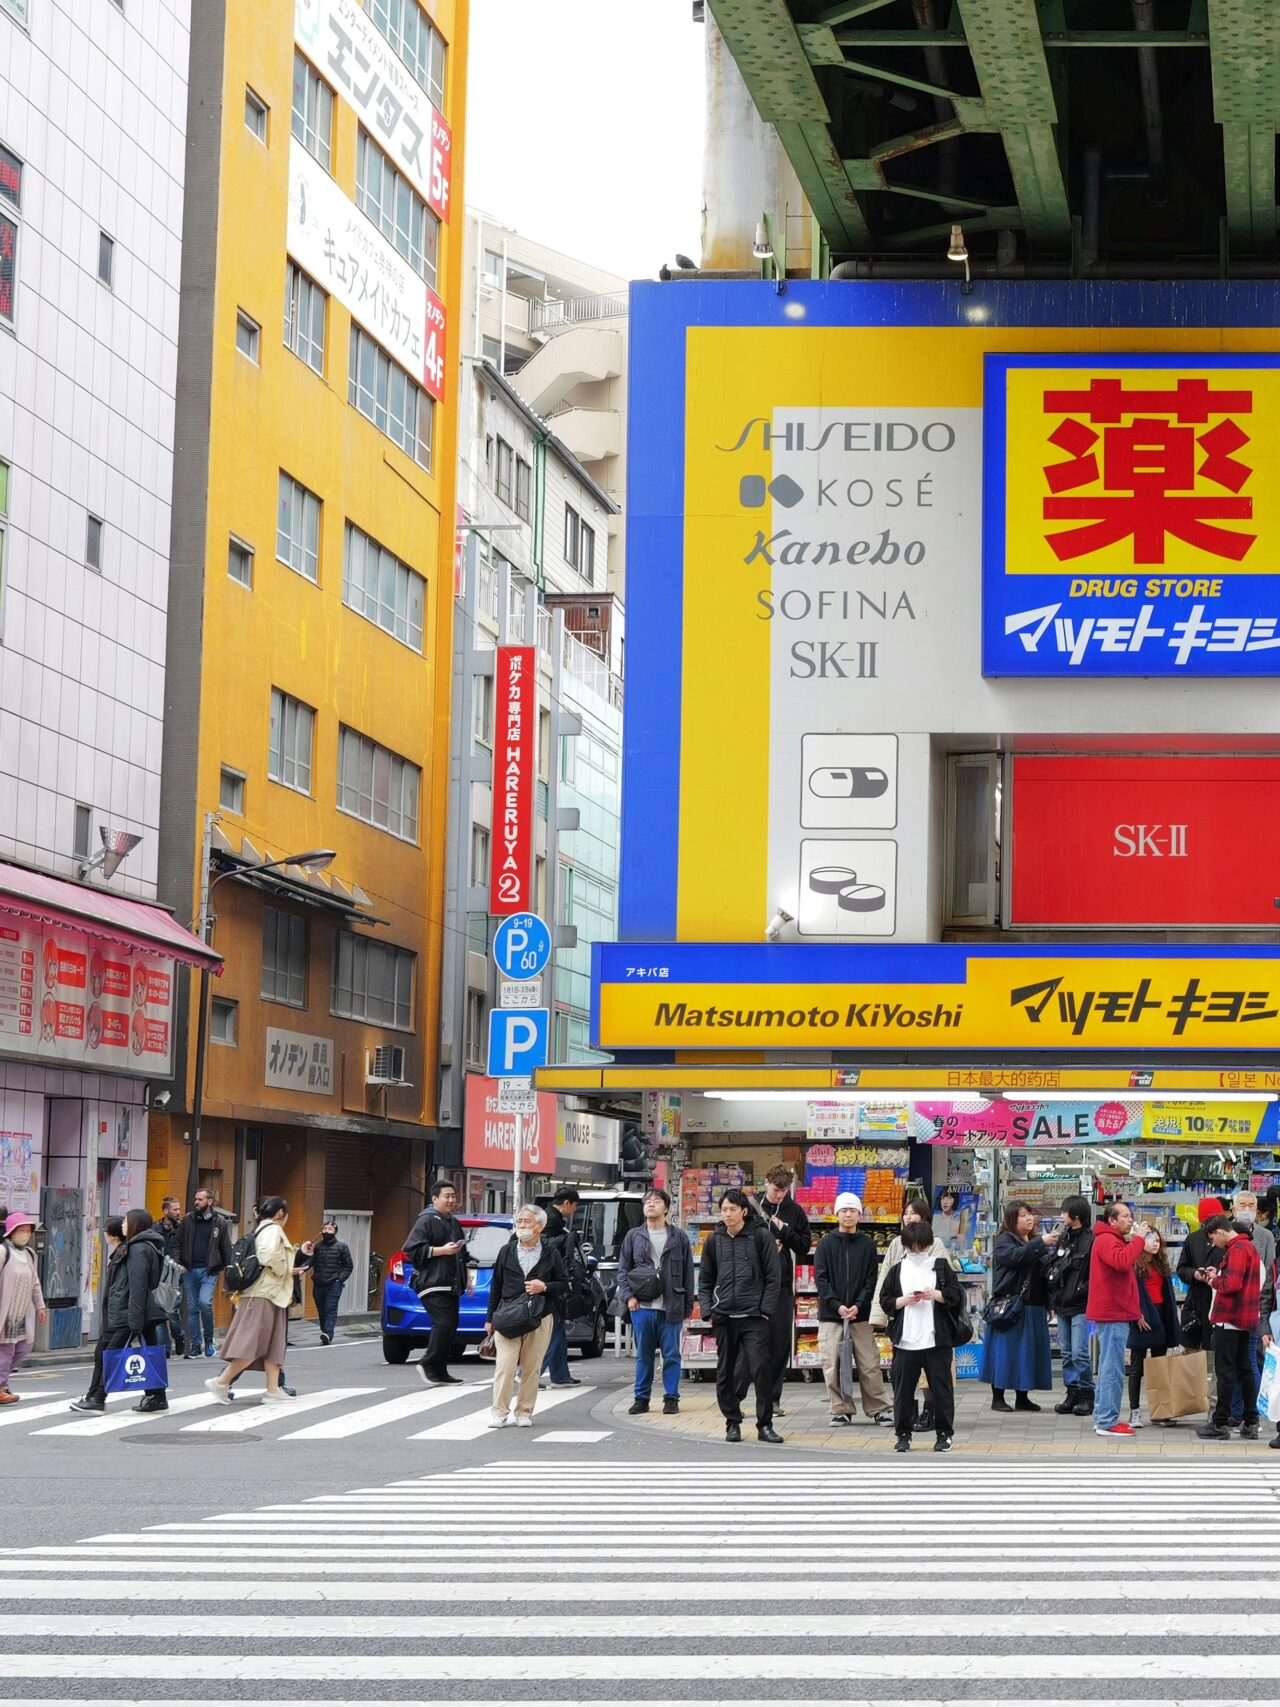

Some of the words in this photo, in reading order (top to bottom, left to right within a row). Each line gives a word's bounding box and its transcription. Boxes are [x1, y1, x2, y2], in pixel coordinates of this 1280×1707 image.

[327, 13, 424, 182] エンタス
[432, 120, 450, 151] オノデン
[431, 147, 448, 210] 5F
[323, 227, 421, 362] キュアメイドカフェ
[426, 300, 445, 329] オノデン
[424, 331, 444, 389] 4F
[715, 417, 956, 453] SHISEIDO
[1042, 377, 1259, 565] 薬
[817, 473, 934, 508] KOSÉ
[743, 528, 927, 567] Kanebo
[1069, 578, 1139, 599] DRUG
[1143, 578, 1224, 599] STORE
[756, 589, 917, 622] SOFINA
[789, 640, 880, 679] SK-II
[507, 655, 523, 741] ポケカ専門店
[503, 747, 521, 870] HARERUYA
[1113, 824, 1188, 857] SK-II
[498, 873, 521, 903] 2
[513, 918, 533, 929] 9-19
[506, 929, 529, 970] P
[520, 951, 537, 970] 60
[626, 967, 669, 978] アキバ店
[502, 995, 538, 1005] ここから
[654, 1002, 840, 1028] Matsumoto
[845, 1002, 963, 1028] KiYoshi
[1010, 976, 1279, 1036] マツモトキヨシ
[269, 1040, 308, 1077] オノデン
[504, 1016, 538, 1070] P
[947, 1070, 1059, 1088] 日本最大的药店
[501, 1101, 535, 1110] ここから
[932, 1115, 959, 1128] 春の
[485, 1119, 533, 1152] HARERYA
[565, 1121, 590, 1145] mouse
[932, 1128, 1009, 1142] スタートアップ
[1012, 1113, 1089, 1140] SALE
[1097, 1119, 1123, 1129] 当たる!
